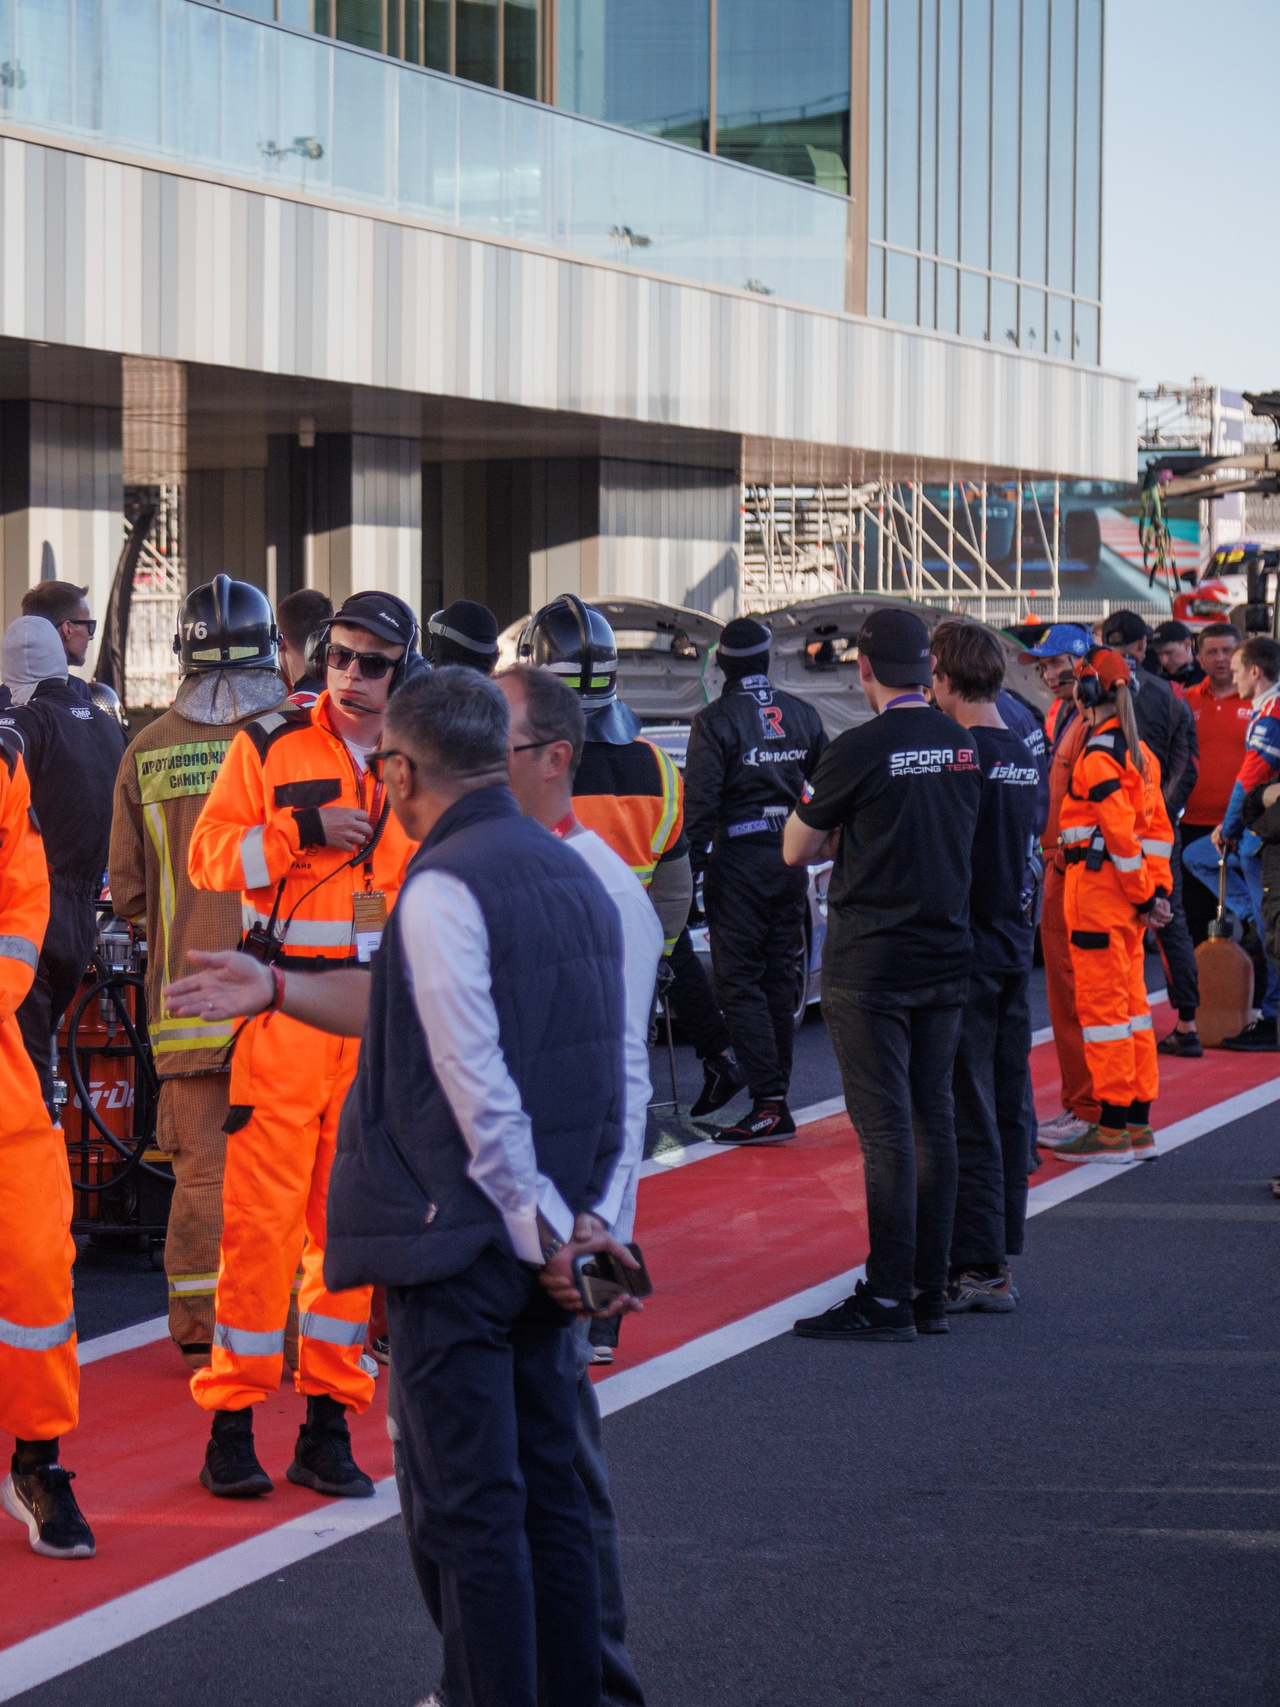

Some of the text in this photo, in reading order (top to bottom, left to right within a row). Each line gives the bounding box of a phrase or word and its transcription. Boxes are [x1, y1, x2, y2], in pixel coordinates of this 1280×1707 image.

[183, 621, 208, 641] 76
[890, 749, 974, 769] SPORA GT
[169, 770, 218, 789] САНКТ-П
[891, 763, 982, 777] RACING TEAM
[989, 761, 1036, 780] iskra
